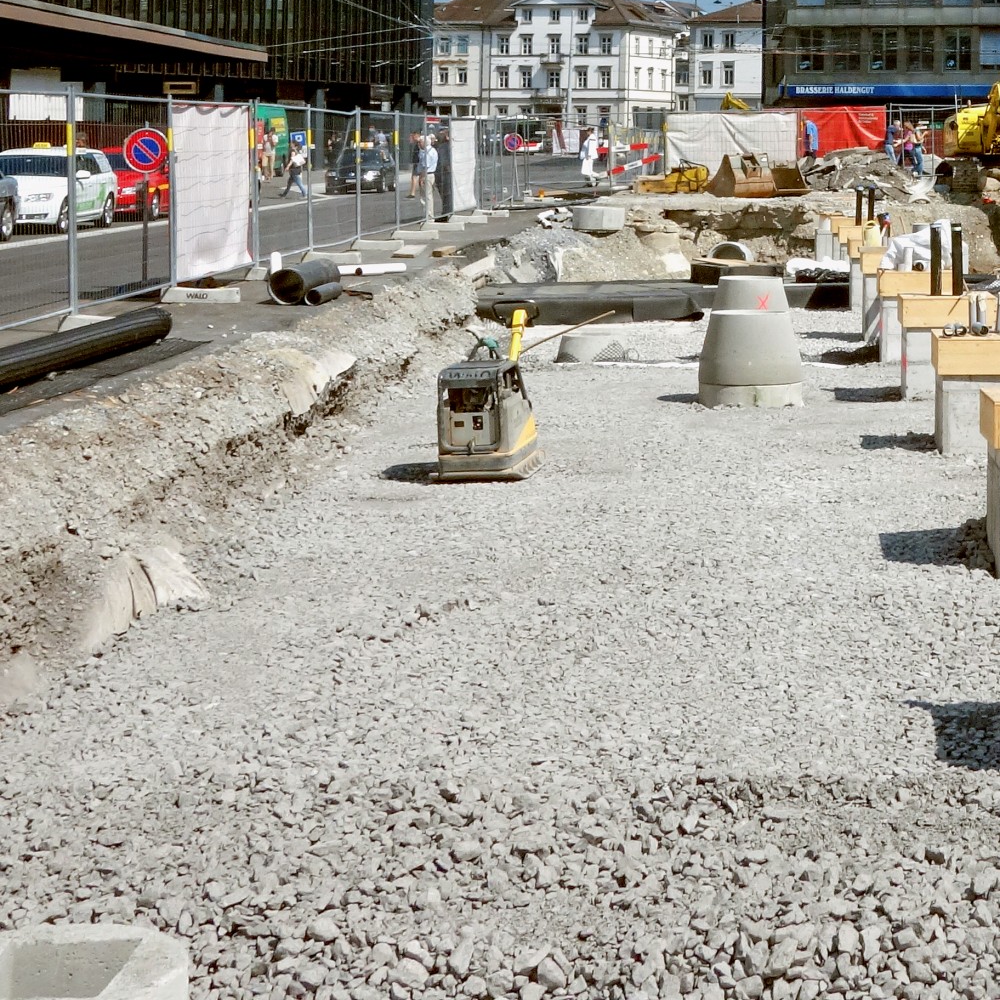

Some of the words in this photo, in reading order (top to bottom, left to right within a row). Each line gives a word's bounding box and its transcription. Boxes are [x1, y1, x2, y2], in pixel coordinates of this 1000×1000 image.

[795, 86, 834, 94] BRASSERIE
[834, 86, 875, 94] HALDENGUT
[186, 292, 209, 300] WALO
